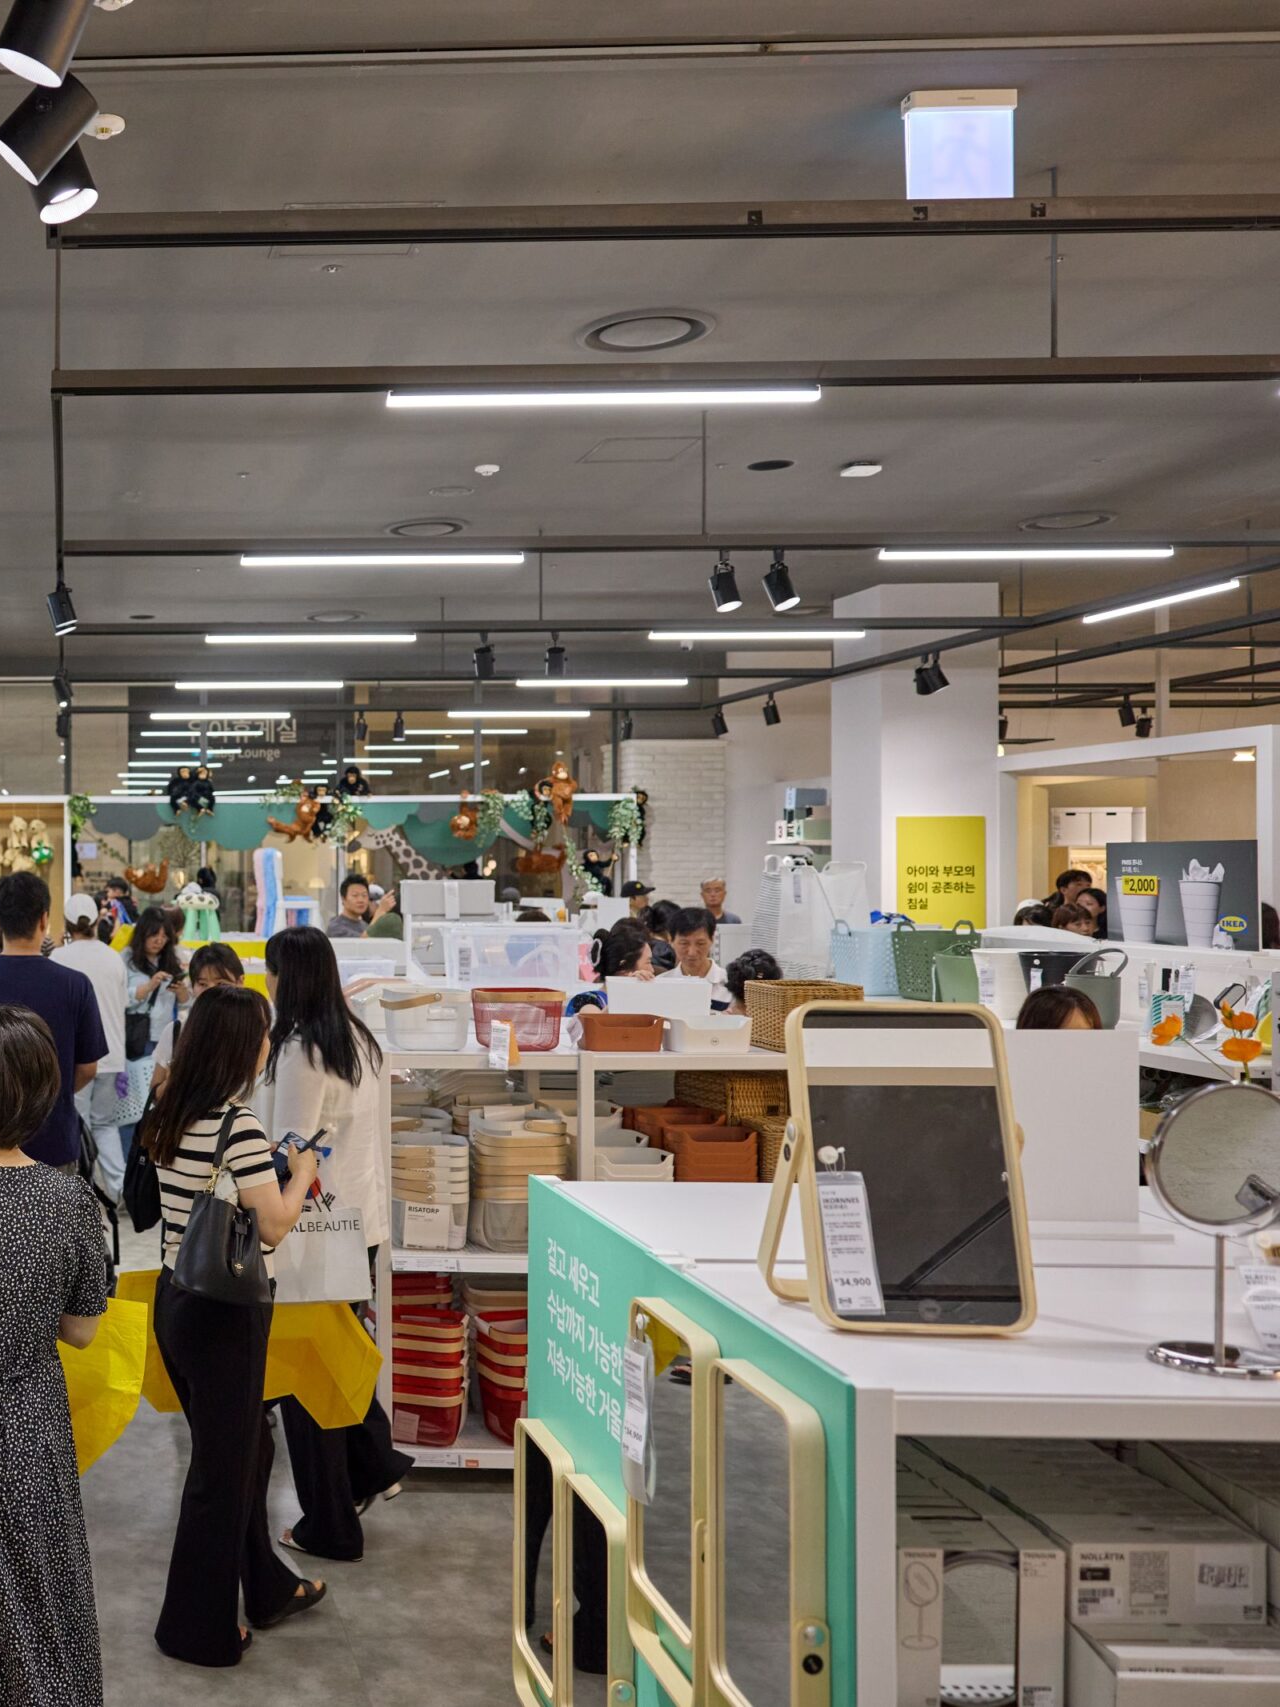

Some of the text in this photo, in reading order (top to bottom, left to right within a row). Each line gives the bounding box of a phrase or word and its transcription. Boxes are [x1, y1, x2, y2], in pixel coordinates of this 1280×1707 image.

[906, 864, 976, 878] 아이와 부모의
[907, 881, 977, 894] 쉼이 공존하는
[906, 897, 929, 910] 침실
[1221, 919, 1245, 929] IKEA
[407, 1205, 440, 1215] RISATORP
[547, 1237, 601, 1308] 걸고 세우고
[547, 1288, 586, 1353] 수납까지
[588, 1324, 622, 1387] 가능한
[547, 1338, 596, 1417] 지속가능한
[599, 1388, 622, 1443] 거울
[1079, 1552, 1125, 1561] NOLLÄTTA
